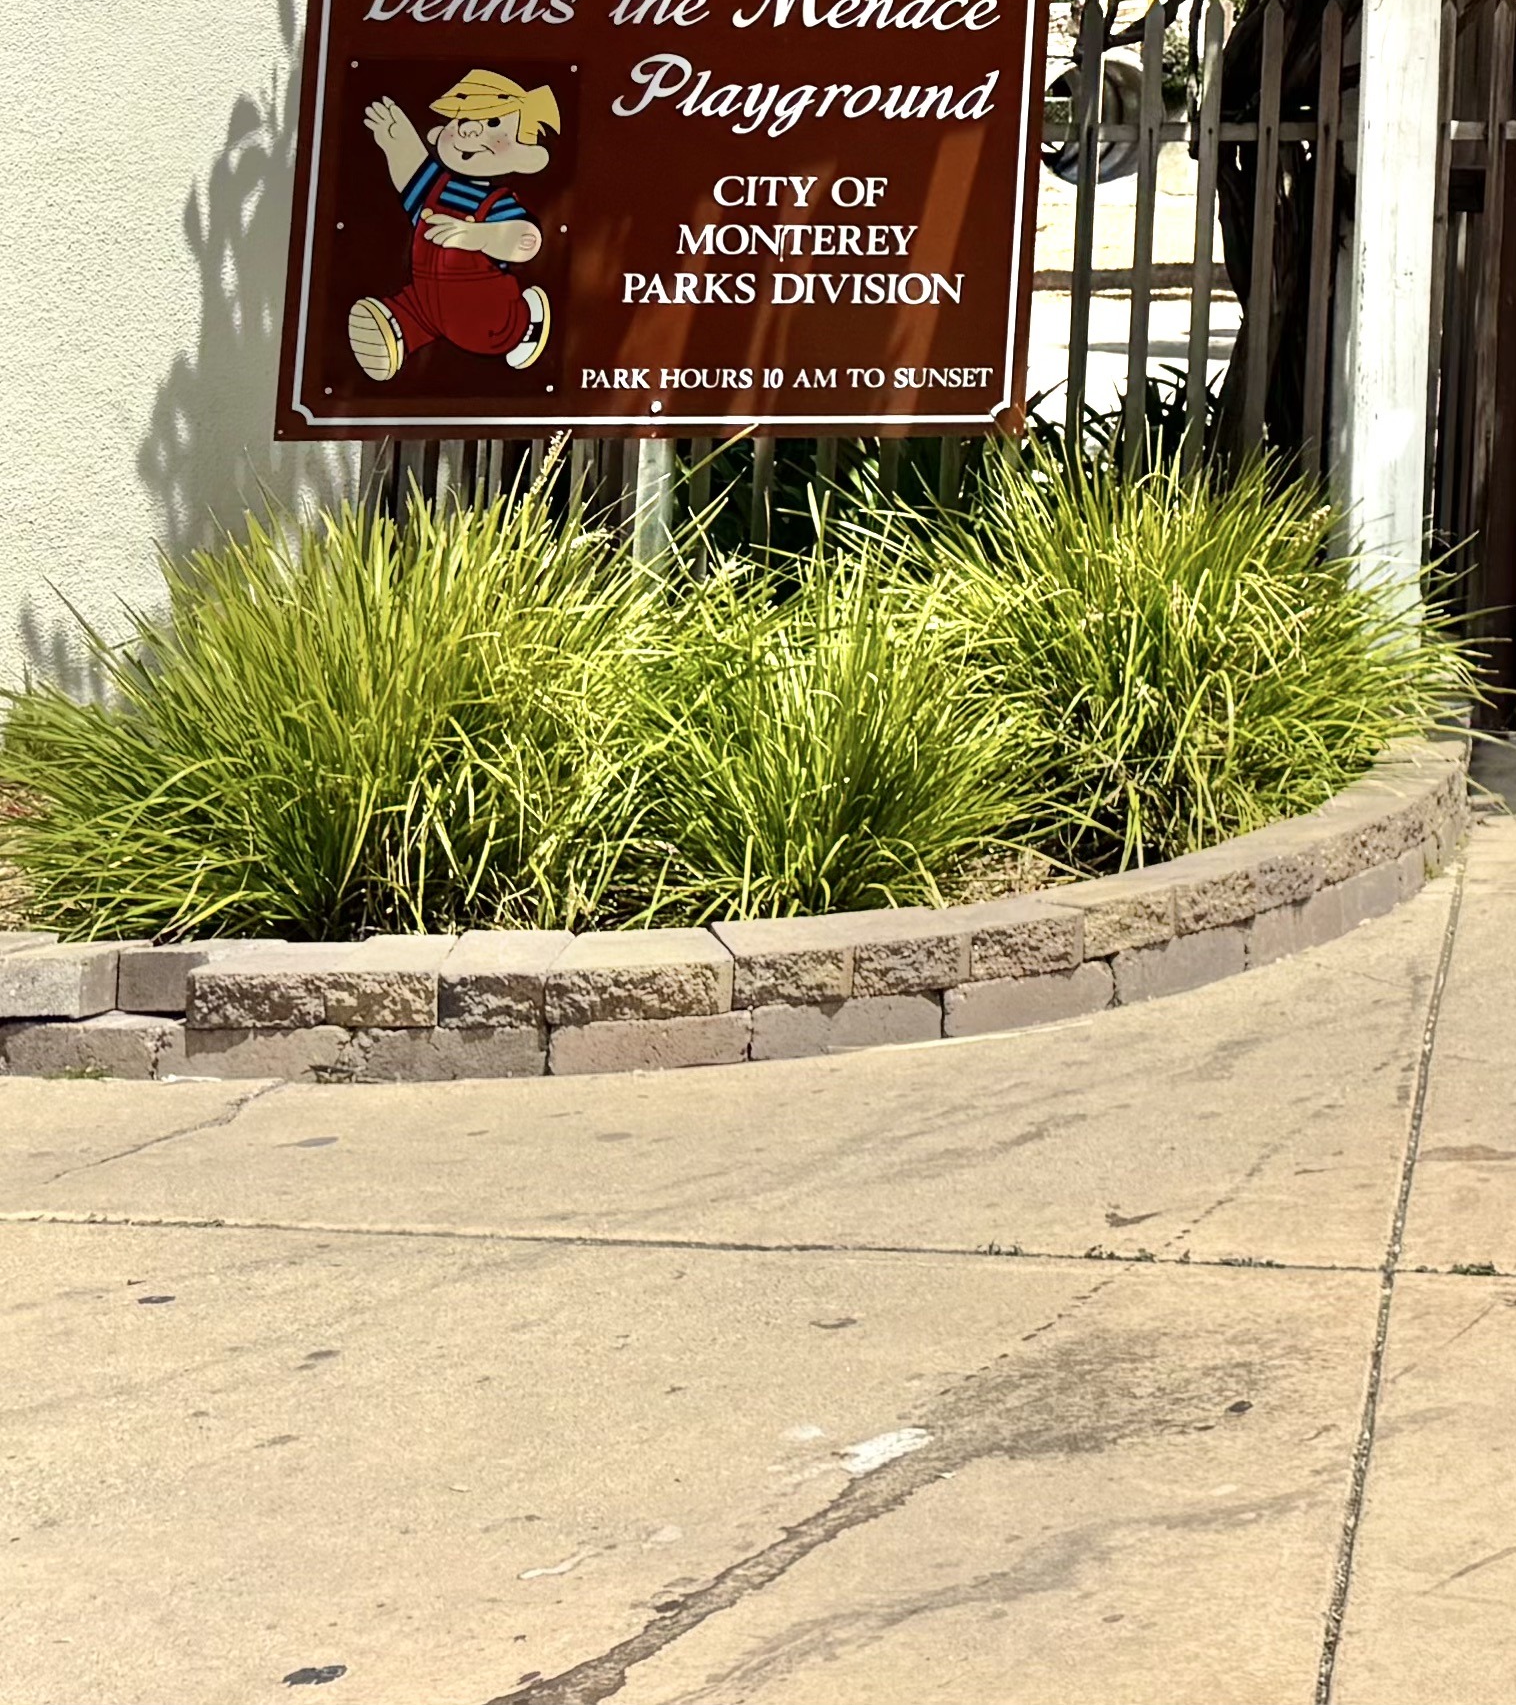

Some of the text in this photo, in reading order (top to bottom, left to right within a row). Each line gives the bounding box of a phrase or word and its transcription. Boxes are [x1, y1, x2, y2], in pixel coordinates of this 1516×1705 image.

[612, 54, 1000, 138] Playground
[713, 175, 888, 208] CITY OF
[675, 224, 919, 257] MONTEREY
[621, 272, 966, 305] PARKS DIVISION
[580, 367, 994, 390] PARK HOURS 10 AM TO SUNSET
